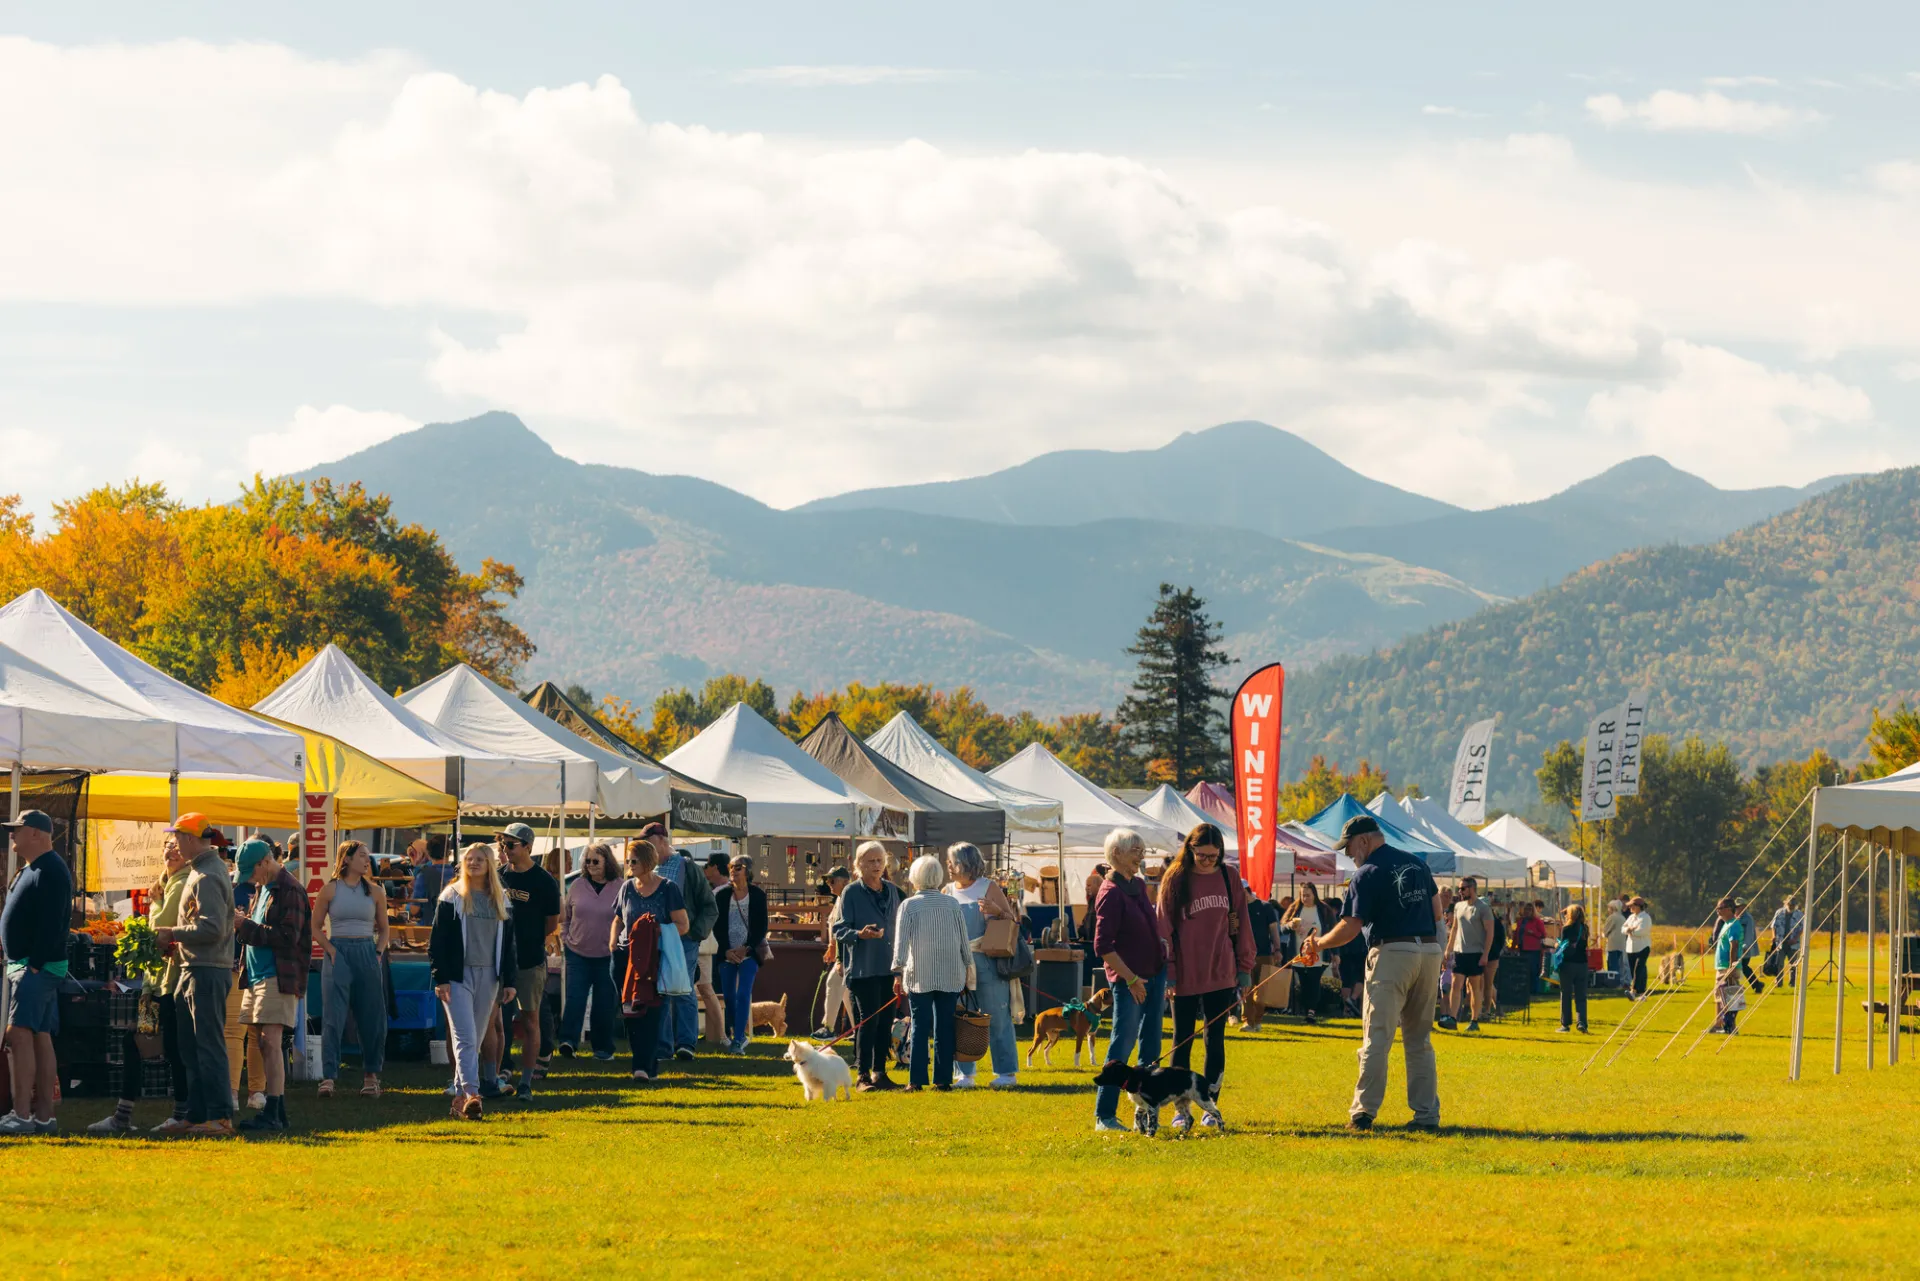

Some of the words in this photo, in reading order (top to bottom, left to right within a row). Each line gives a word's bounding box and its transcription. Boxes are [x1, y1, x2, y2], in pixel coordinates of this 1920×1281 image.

[1241, 694, 1272, 857] WINERY
[1464, 745, 1486, 803] PIES
[1594, 720, 1615, 809] CIDER
[1621, 703, 1643, 784] FRUIT
[305, 795, 328, 958] VEGETA
